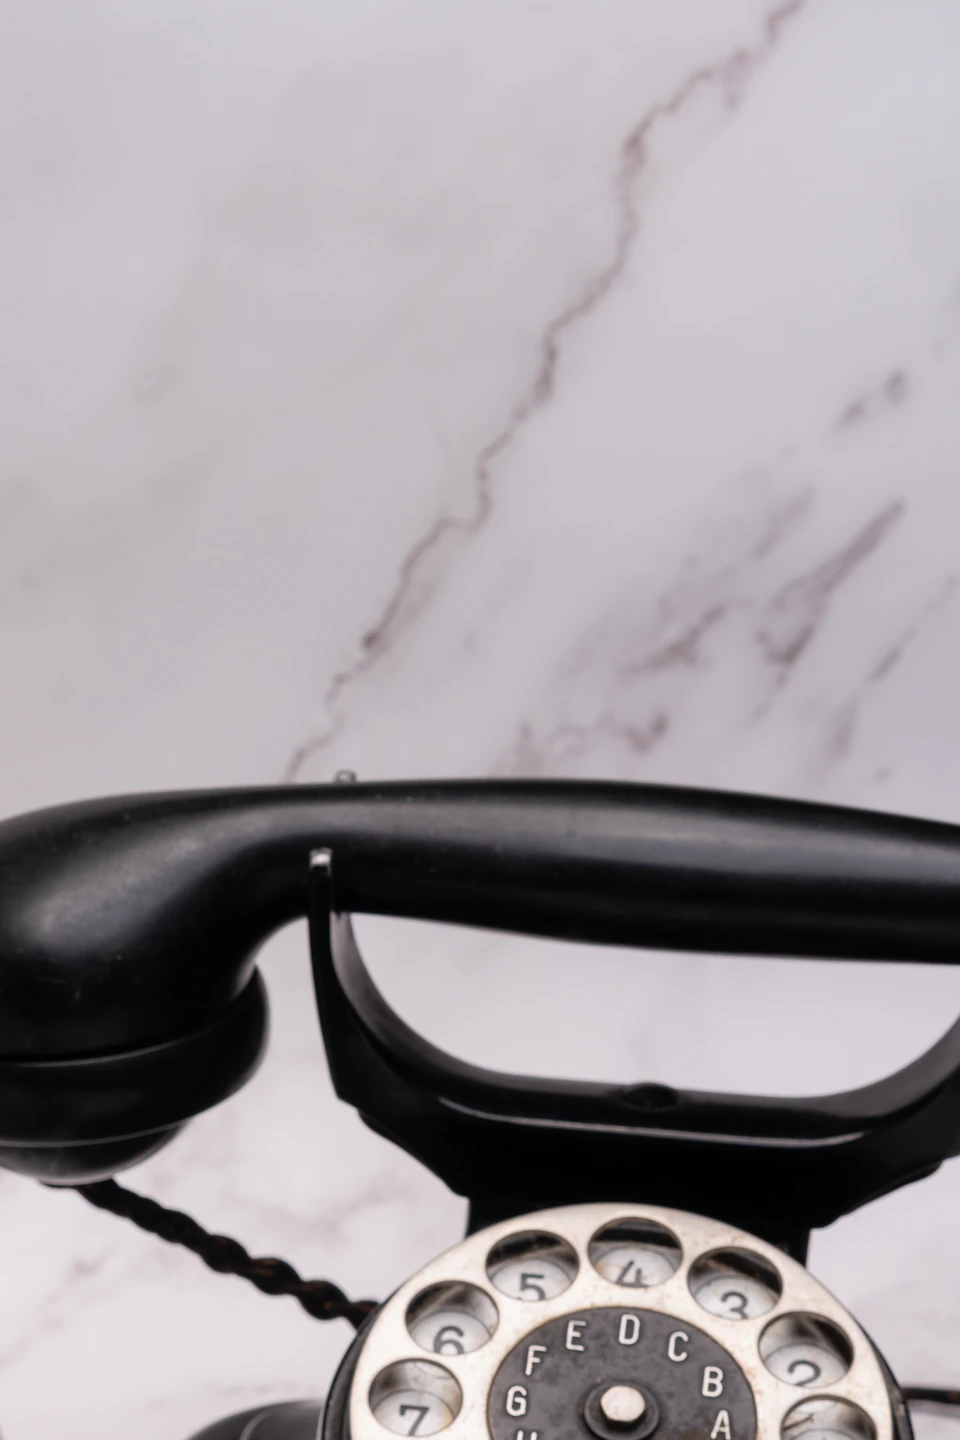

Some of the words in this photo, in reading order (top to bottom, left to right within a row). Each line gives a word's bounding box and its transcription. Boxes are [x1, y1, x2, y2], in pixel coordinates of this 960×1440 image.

[517, 1273, 546, 1301] 5
[615, 1260, 649, 1288] 4
[433, 1326, 464, 1355] 6
[565, 1320, 587, 1352] E
[618, 1314, 640, 1345] D
[525, 1345, 547, 1376] F
[667, 1331, 689, 1362] C
[702, 1366, 724, 1398] B
[787, 1360, 821, 1386] 2
[506, 1385, 527, 1416] G
[399, 1404, 429, 1436] 7
[710, 1410, 732, 1440] A
